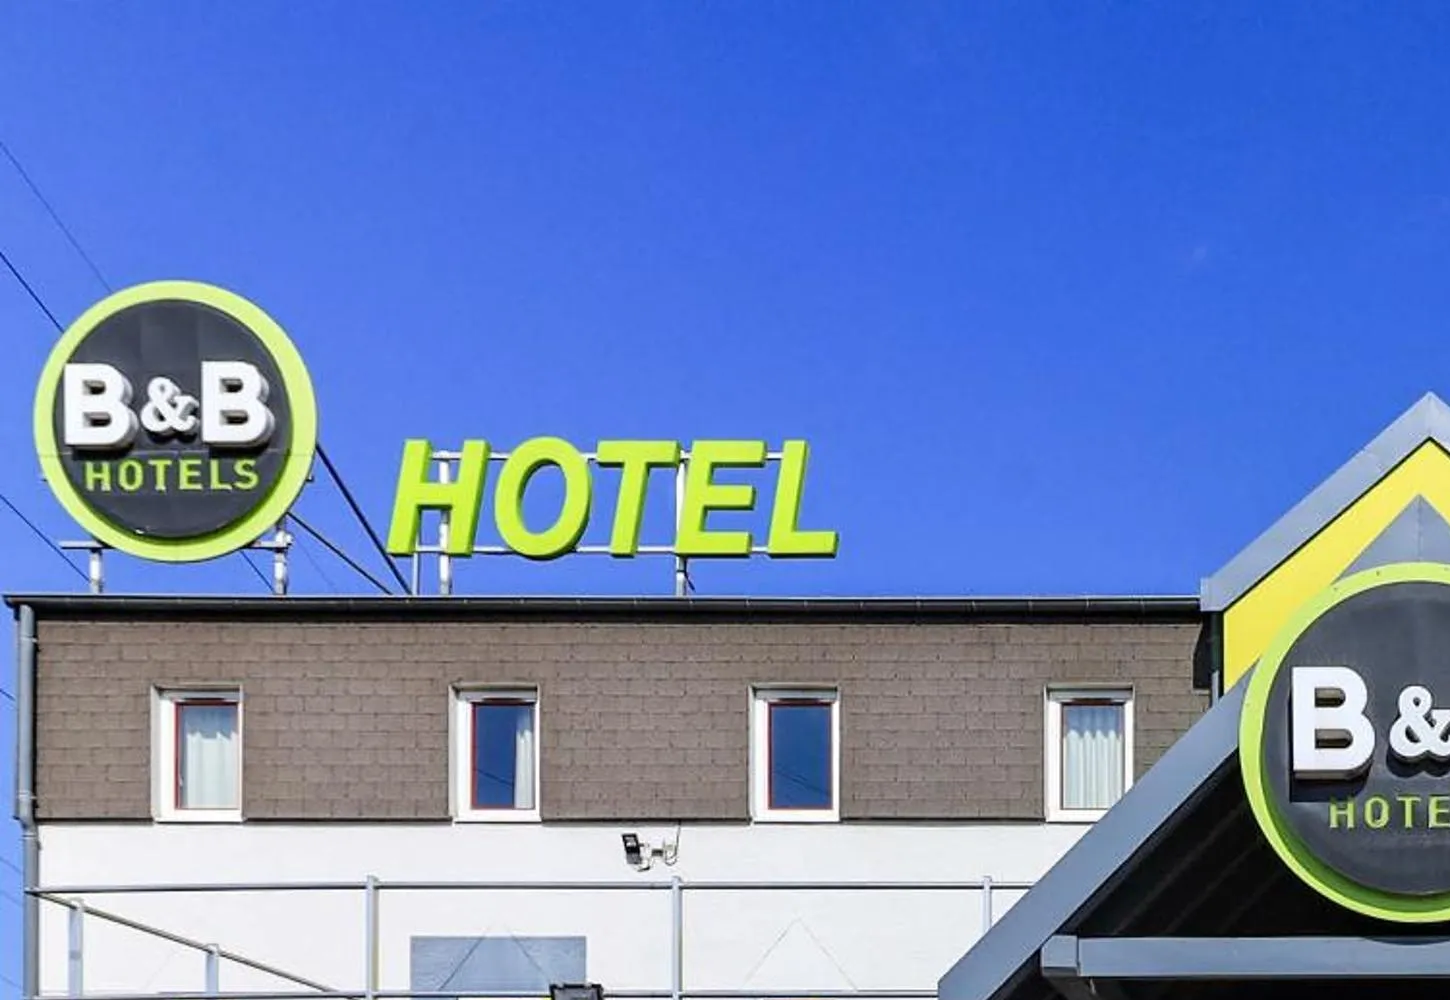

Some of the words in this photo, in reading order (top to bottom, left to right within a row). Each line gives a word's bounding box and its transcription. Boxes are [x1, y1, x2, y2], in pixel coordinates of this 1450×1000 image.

[64, 360, 275, 447] B&B
[84, 458, 260, 492] HOTELS
[387, 436, 839, 559] HOTEL
